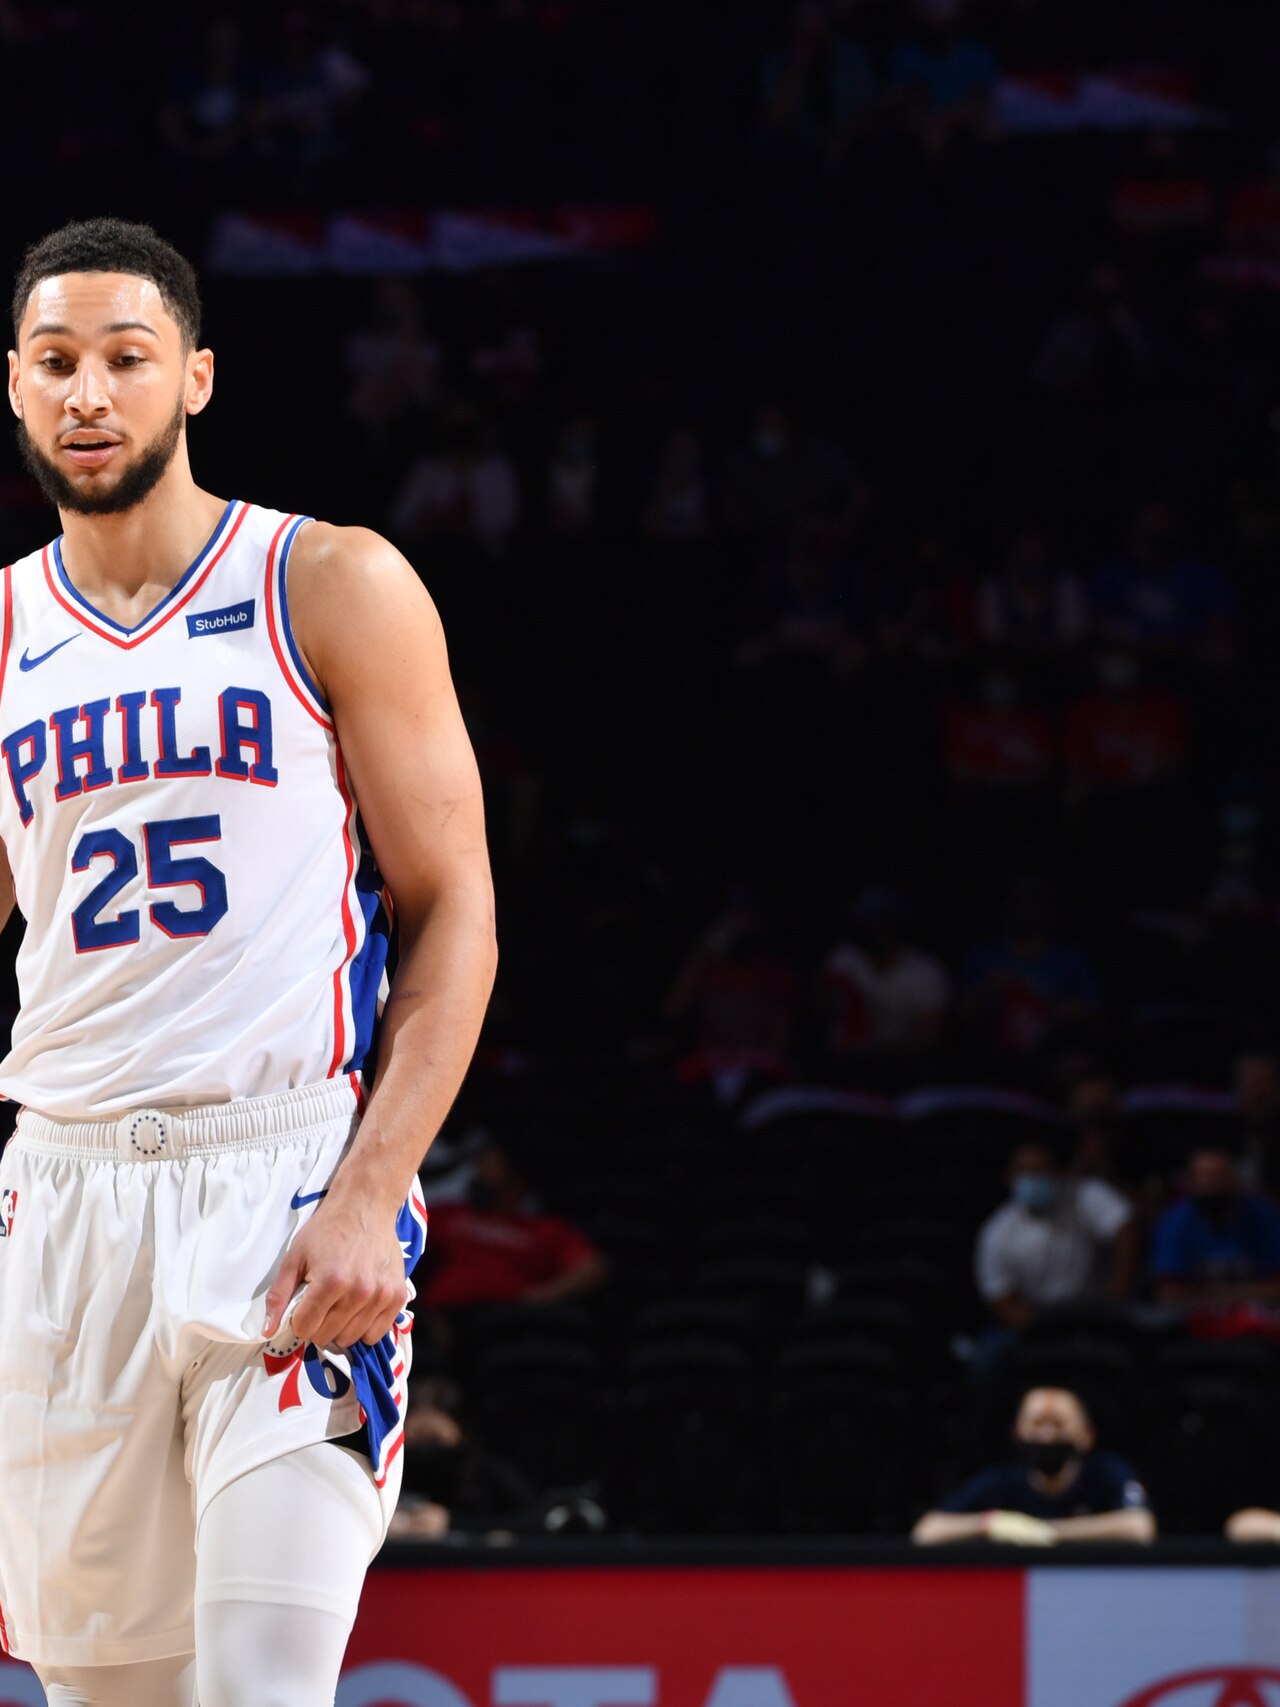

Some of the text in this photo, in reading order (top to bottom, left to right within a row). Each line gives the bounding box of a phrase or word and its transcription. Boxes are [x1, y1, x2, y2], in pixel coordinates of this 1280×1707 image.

[195, 612, 248, 631] StubHub
[1, 686, 279, 829] PHILA
[71, 813, 229, 954] 25
[263, 1341, 351, 1414] 76
